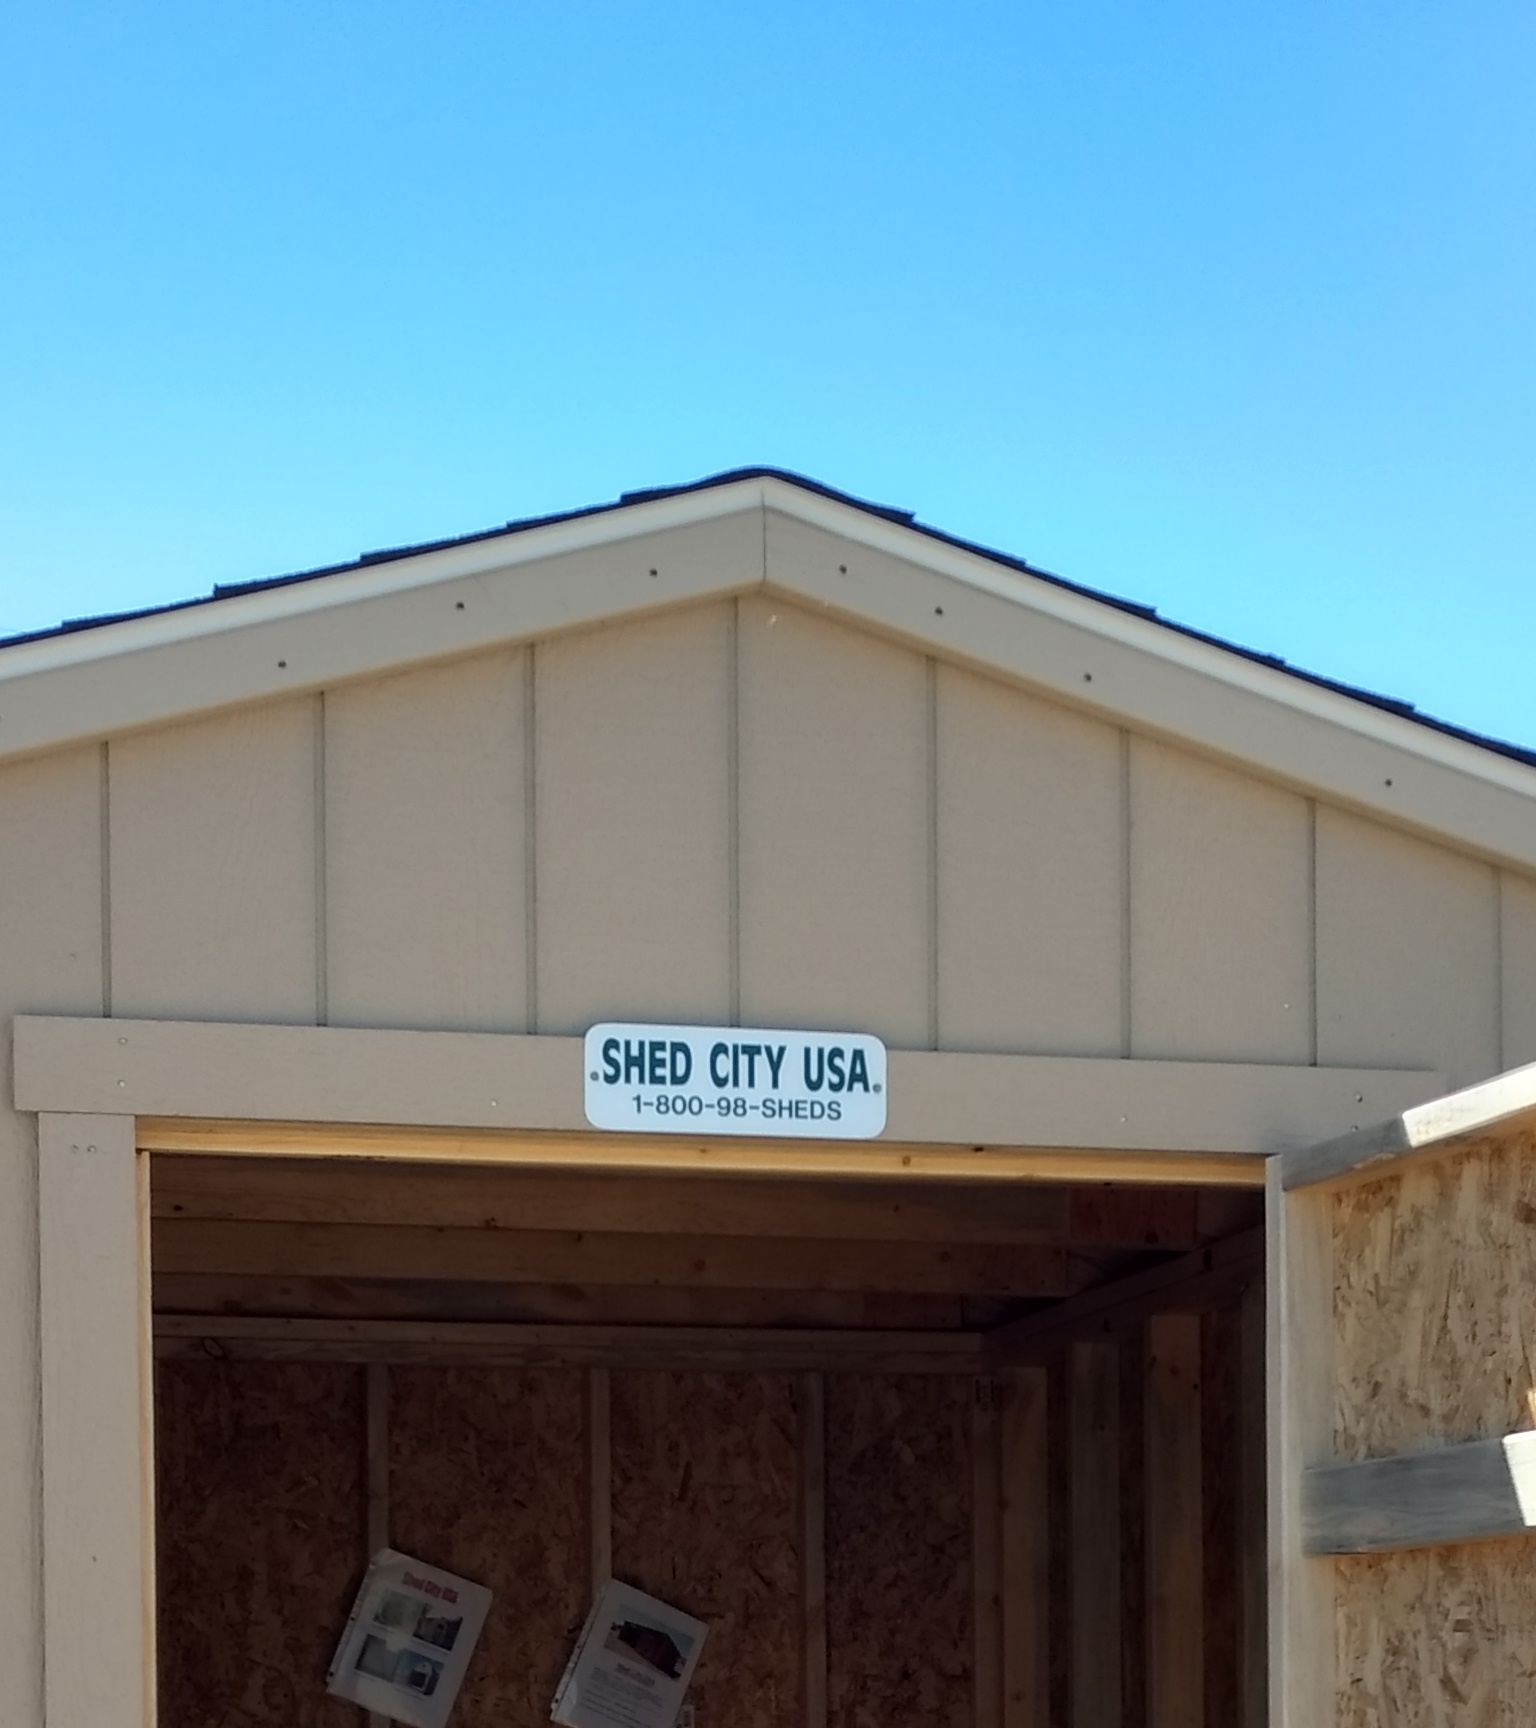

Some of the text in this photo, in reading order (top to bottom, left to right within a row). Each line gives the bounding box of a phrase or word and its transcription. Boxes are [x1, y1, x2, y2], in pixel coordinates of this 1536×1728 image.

[602, 1038, 871, 1094] SHED CITY USA
[632, 1094, 843, 1121] 1-800-98-SHEDS
